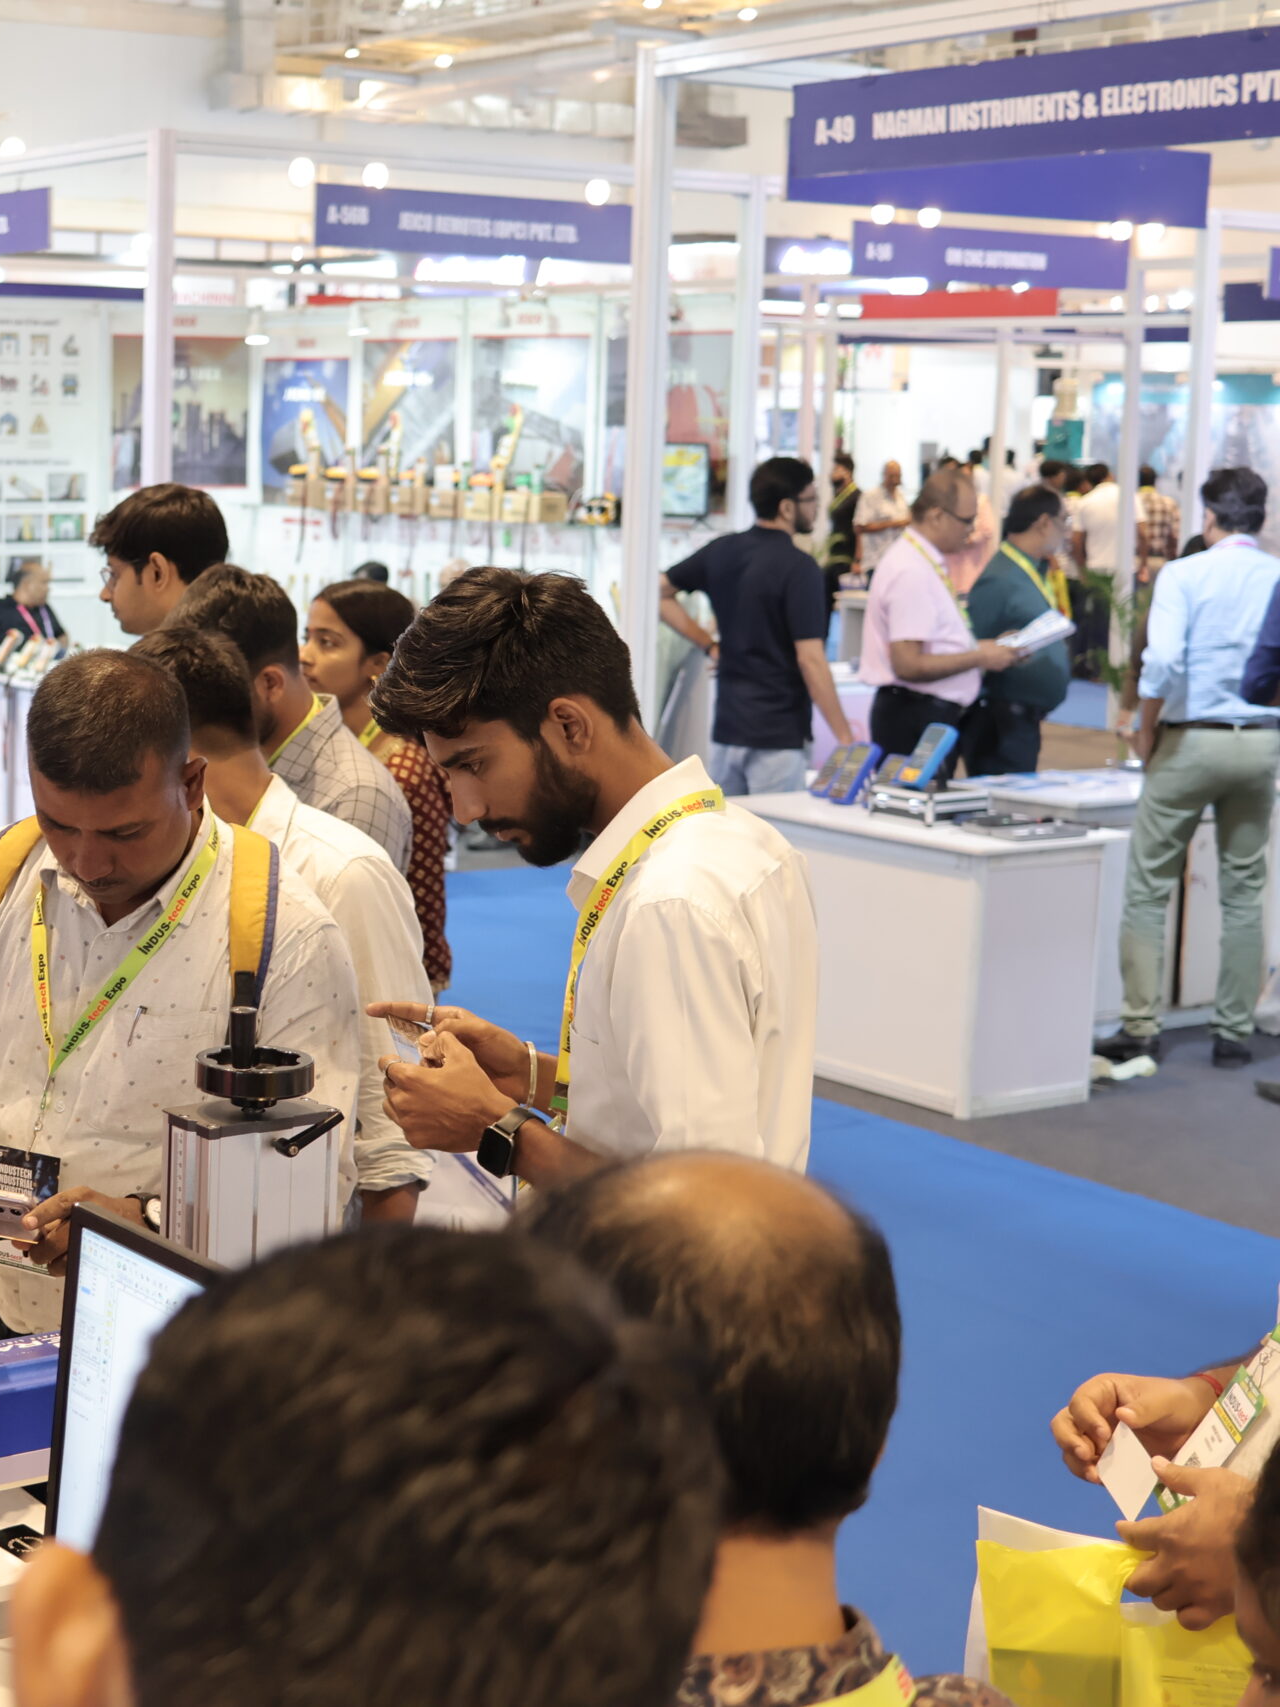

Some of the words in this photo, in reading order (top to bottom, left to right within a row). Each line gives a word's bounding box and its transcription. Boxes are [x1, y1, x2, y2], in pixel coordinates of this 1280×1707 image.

[814, 114, 856, 146] A-49
[872, 105, 948, 140] NAGMAN
[949, 89, 1080, 133] INSTRUMENTS
[1082, 92, 1099, 119] &
[1100, 73, 1240, 117] ELECTRONICS
[181, 874, 201, 899] Expo
[605, 861, 629, 888] Expo
[37, 953, 47, 982] Expo
[104, 976, 127, 1000] Expo
